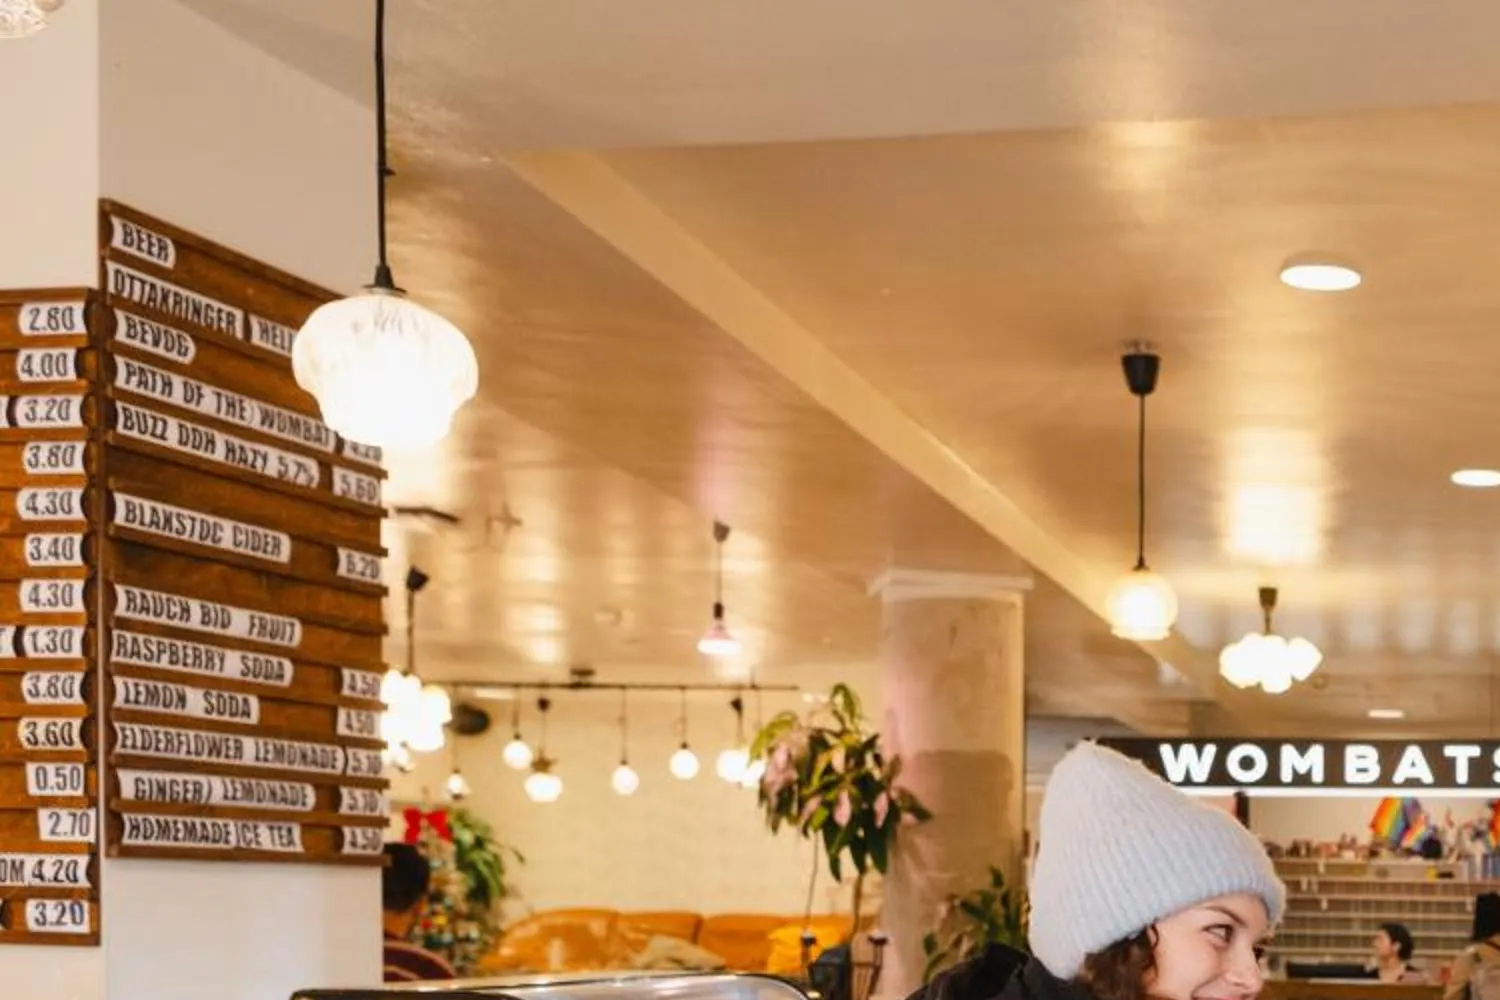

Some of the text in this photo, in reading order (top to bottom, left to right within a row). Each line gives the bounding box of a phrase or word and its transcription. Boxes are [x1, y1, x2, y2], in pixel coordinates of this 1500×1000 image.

[121, 223, 170, 264] BEER
[113, 268, 237, 336] OTTAKRINGER
[28, 306, 75, 332] 2.80
[21, 352, 68, 377] 4.00
[24, 398, 71, 422] 3.20
[124, 362, 173, 397] PATH
[182, 380, 205, 406] OF
[213, 391, 246, 421] THE
[258, 404, 329, 447] WOMBAT
[121, 405, 168, 441] BUZZ
[224, 438, 269, 473] HAZY
[27, 444, 76, 469] 3.80
[25, 491, 73, 516] 4.30
[124, 500, 224, 545] BLAKSTOC
[232, 524, 282, 557] CIDER
[29, 536, 75, 561] 3.40
[28, 582, 74, 608] 4.30
[124, 589, 190, 623] RAUCH
[248, 614, 296, 644] FRUIT
[29, 628, 74, 653] 1.30
[115, 633, 225, 673] RASPBERRY
[240, 653, 286, 682] SODA
[27, 674, 75, 699] 3.80
[122, 681, 187, 711] LEMON
[202, 690, 252, 719] SODA
[25, 721, 74, 747] 3.60
[119, 725, 243, 761] ELDERFLOWER
[254, 739, 339, 770] LEMONADE
[35, 765, 81, 791] 0.50
[134, 776, 202, 802] GINGER
[221, 779, 308, 808] LEMONADE
[48, 811, 91, 837] 2.70
[127, 817, 231, 845] HOMEMADE
[235, 822, 262, 847] ICE
[269, 824, 296, 848] TEA
[31, 858, 79, 883] 4.20
[34, 901, 85, 927] 3.20
